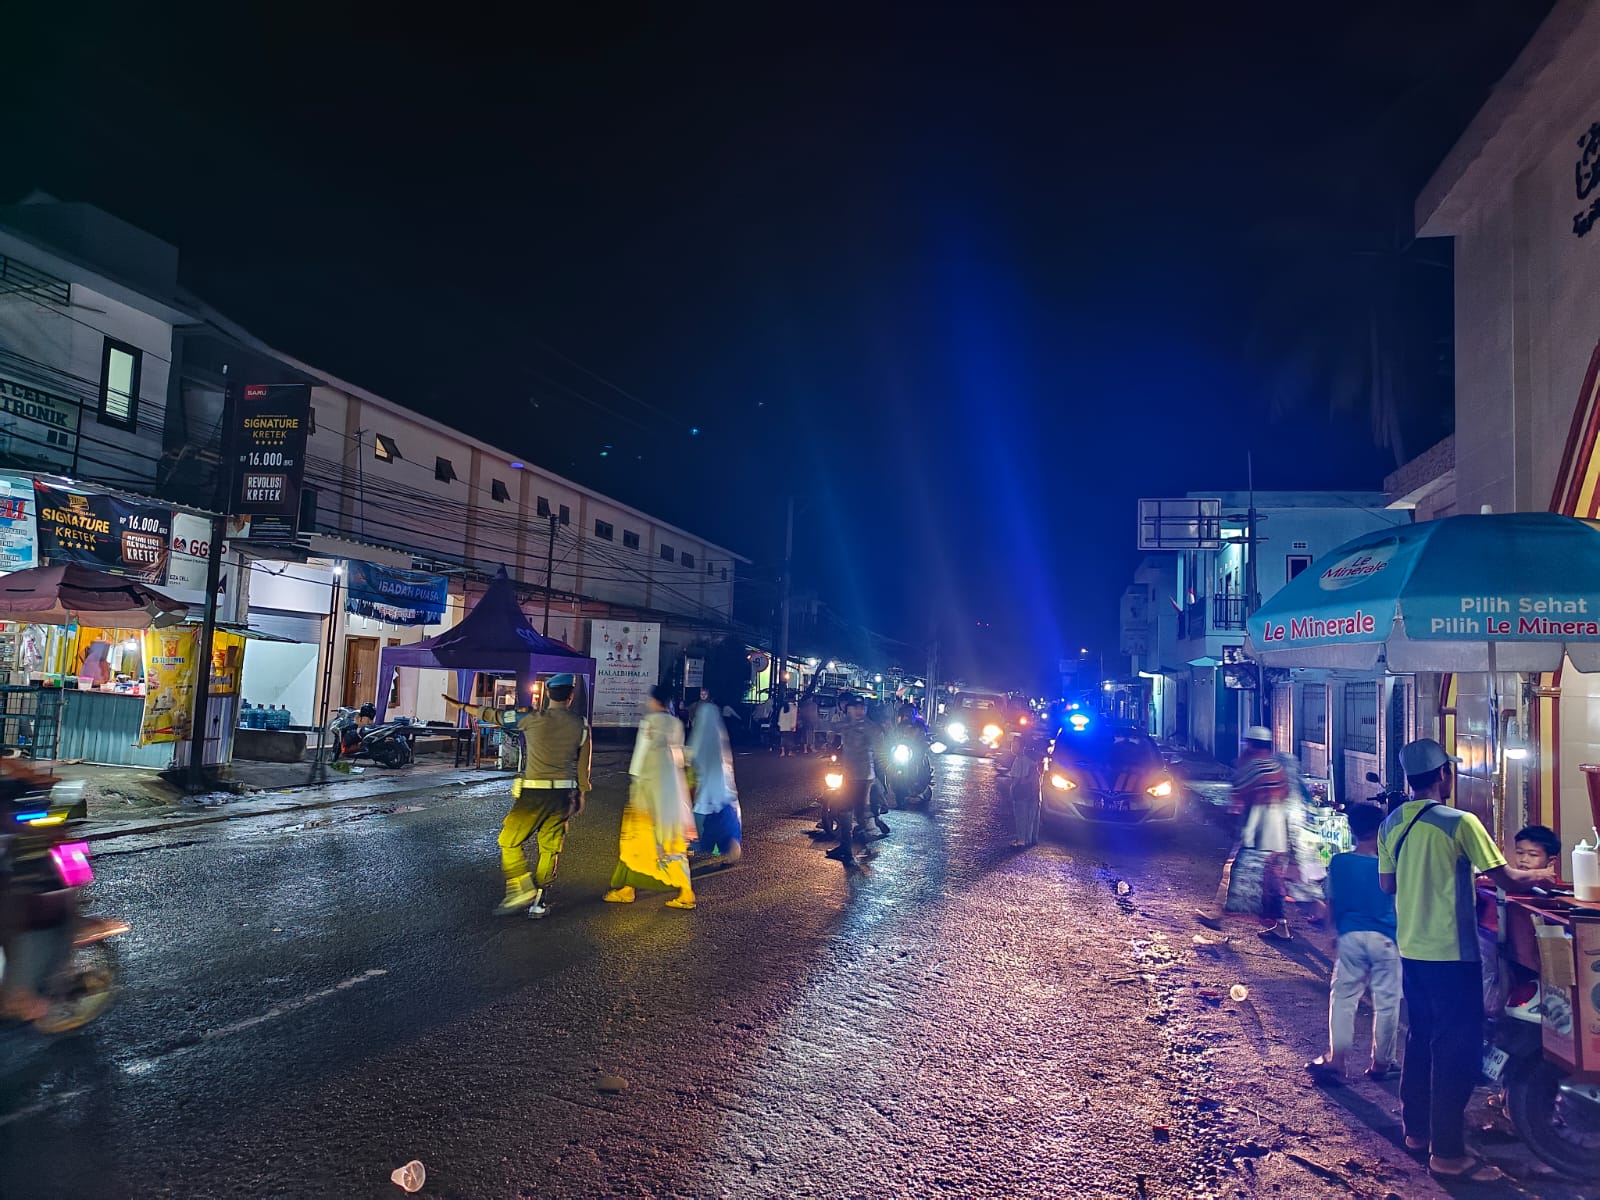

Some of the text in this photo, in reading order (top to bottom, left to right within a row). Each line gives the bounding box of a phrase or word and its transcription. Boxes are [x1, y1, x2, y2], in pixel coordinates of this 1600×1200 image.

[12, 383, 55, 409] CELL
[243, 418, 299, 429] SIGNATURE
[252, 430, 288, 439] KRETEK
[248, 452, 283, 466] 16.000
[247, 476, 283, 489] REVOLUSI
[246, 489, 282, 501] KRETEK
[42, 507, 111, 534] SIGNATURE
[128, 514, 160, 533] 16.000
[54, 526, 97, 544] KRETEK
[126, 535, 160, 551] REVOLUSI
[126, 547, 160, 563] KRETEK
[1352, 556, 1373, 567] Le
[1321, 561, 1388, 579] Minerale
[378, 580, 440, 601] IBADAH PUASA
[1460, 597, 1588, 614] Pilih Sehat
[1264, 610, 1375, 641] Le Minerale
[1430, 616, 1600, 636] Pilih Le Minera
